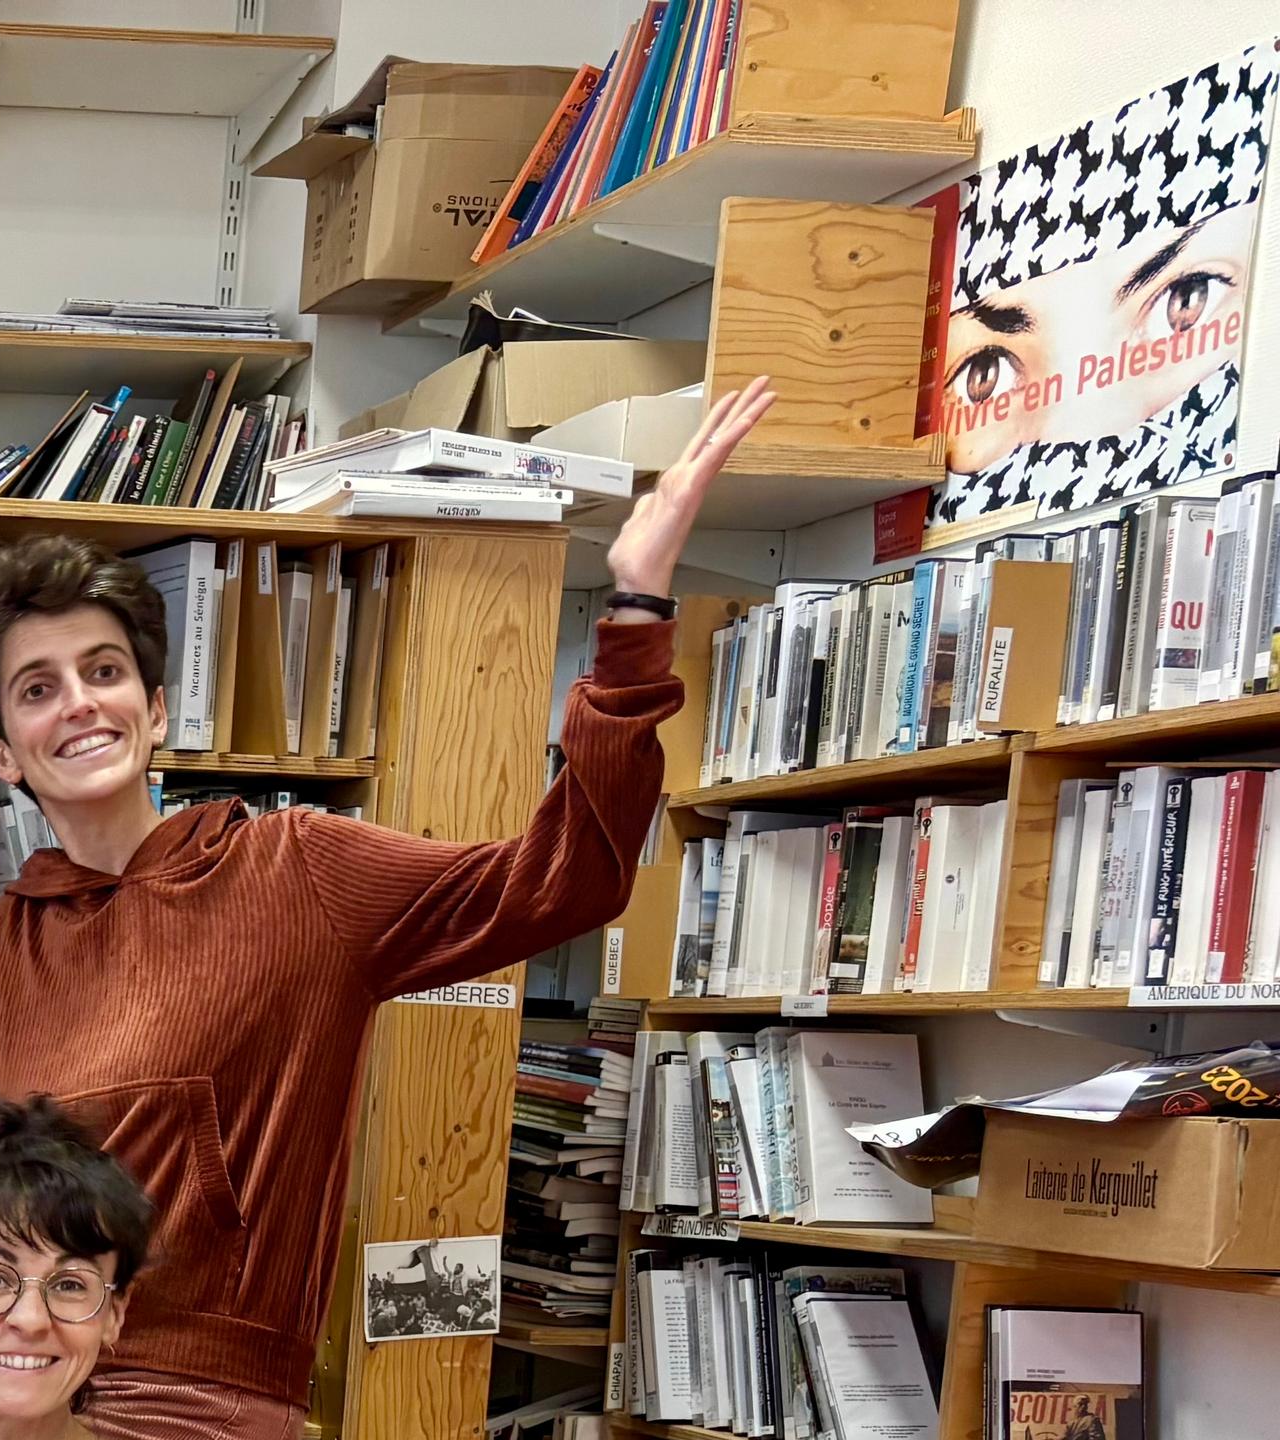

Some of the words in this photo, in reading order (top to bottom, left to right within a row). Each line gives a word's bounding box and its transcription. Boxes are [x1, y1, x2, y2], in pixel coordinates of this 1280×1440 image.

[942, 394, 1010, 439] Vivre
[1023, 373, 1063, 414] en
[1076, 310, 1241, 395] Palestine
[437, 505, 480, 516] KURDISTAN
[194, 576, 206, 622] Sénégal
[195, 626, 203, 641] au
[190, 645, 202, 698] Vacances
[985, 640, 1007, 711] RURALITE
[608, 937, 620, 986] QUEBEC
[1148, 985, 1221, 1001] AMERIQUE
[1225, 985, 1246, 999] DU
[1251, 984, 1280, 999] NOR
[1198, 1063, 1269, 1108] 2023
[1025, 1158, 1068, 1203] Laiterie
[1071, 1166, 1085, 1204] de
[1089, 1157, 1159, 1219] Kerguillet
[656, 1217, 728, 1239] AMERINDIENS
[609, 1350, 624, 1403] CHIAPAS
[1009, 1393, 1108, 1425] SCOTEA
